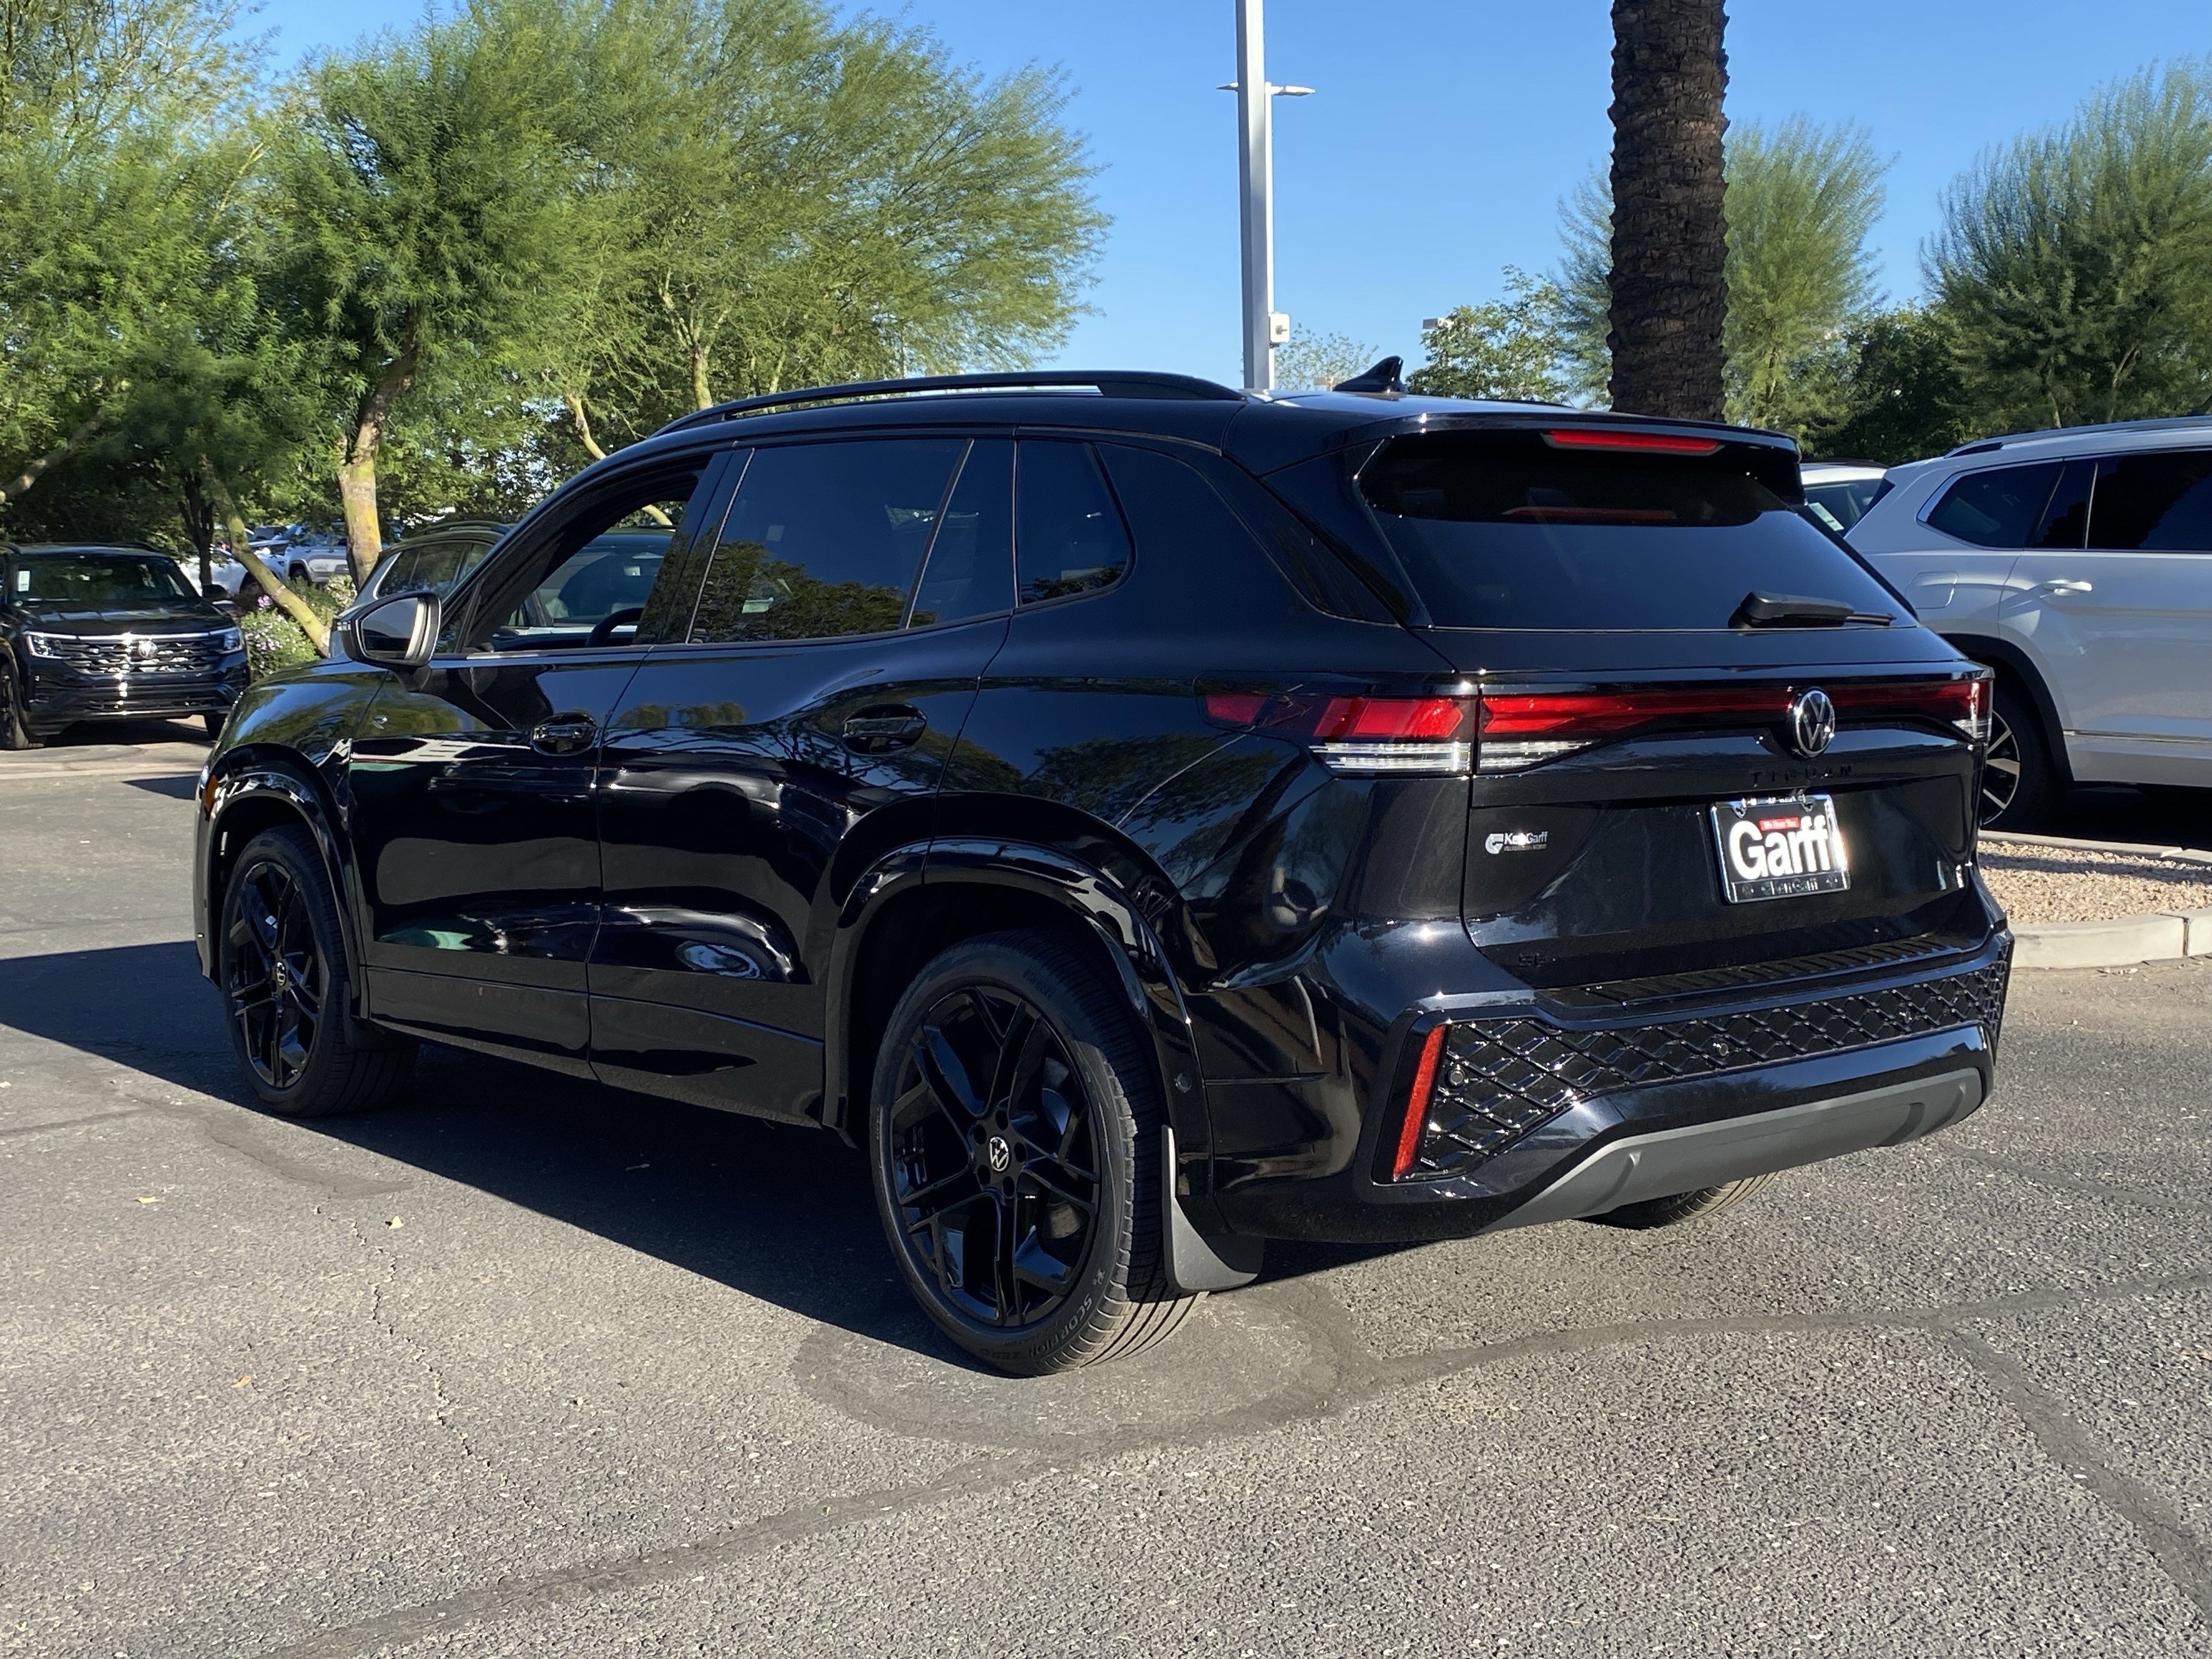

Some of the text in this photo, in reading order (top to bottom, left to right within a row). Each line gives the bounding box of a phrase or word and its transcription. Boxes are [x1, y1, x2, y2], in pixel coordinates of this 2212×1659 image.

[1504, 833, 1526, 845] Ke
[1729, 815, 1831, 879] Garff
[1028, 1293, 1093, 1358] SCORPION
